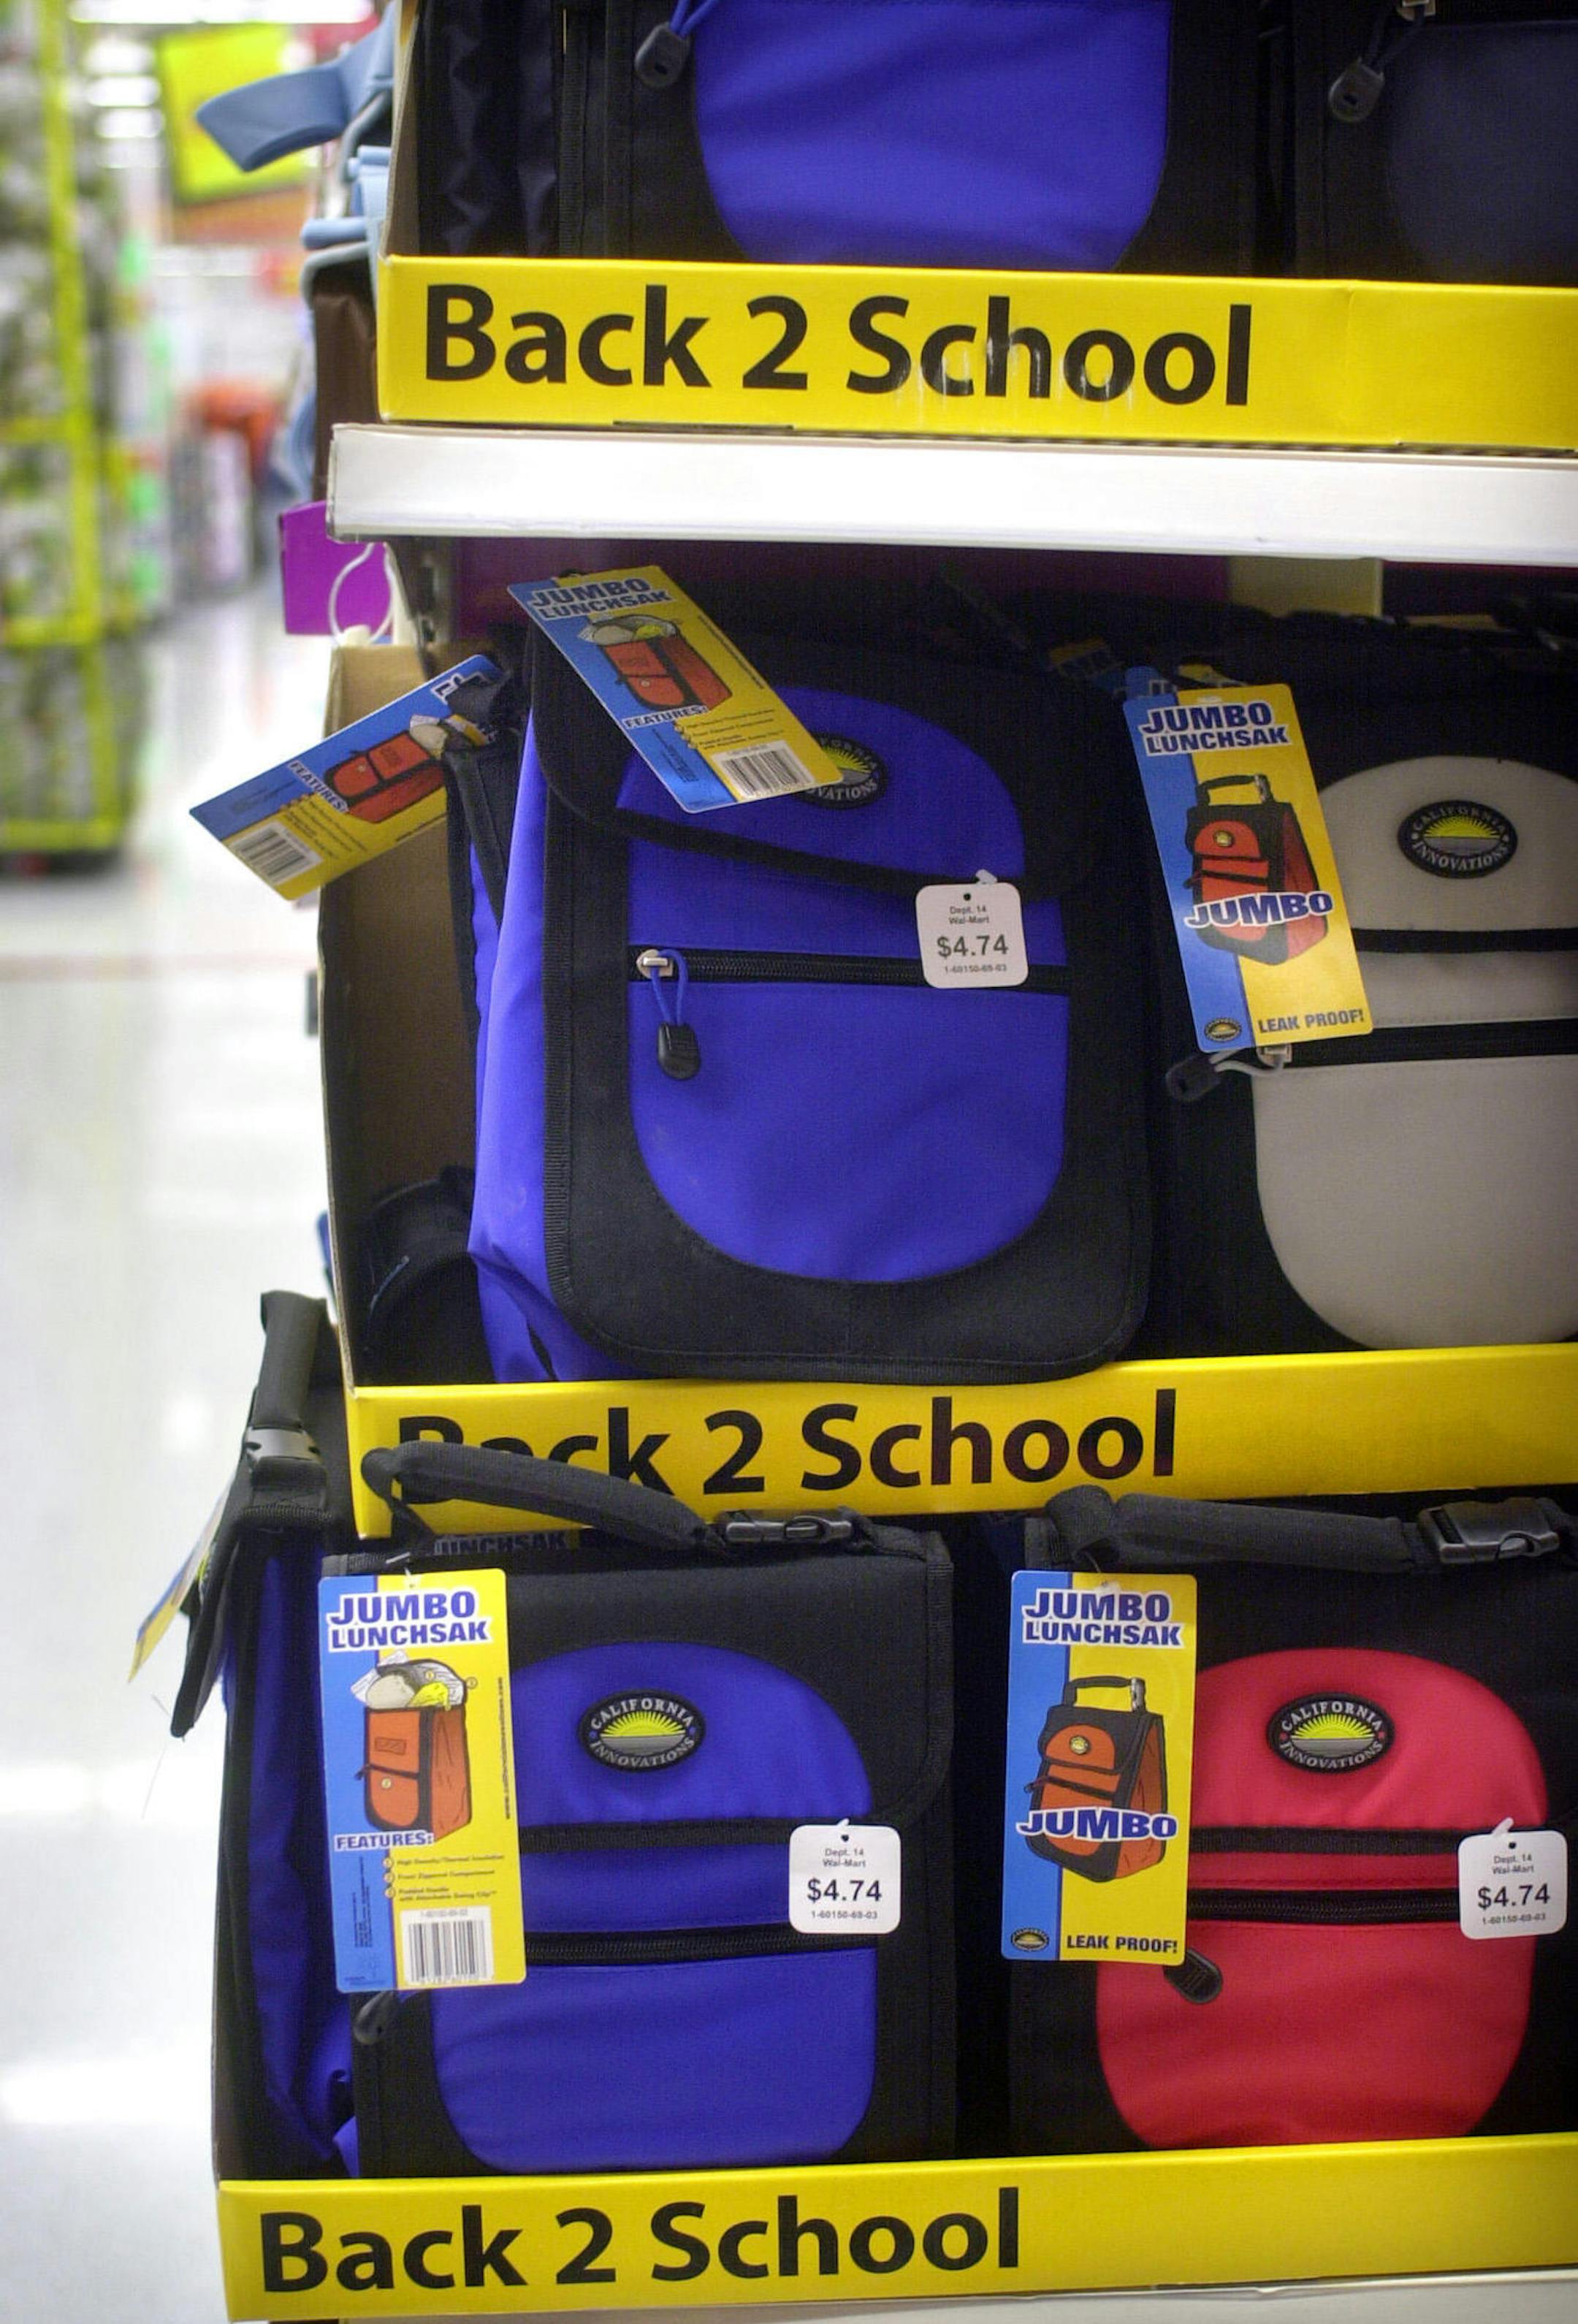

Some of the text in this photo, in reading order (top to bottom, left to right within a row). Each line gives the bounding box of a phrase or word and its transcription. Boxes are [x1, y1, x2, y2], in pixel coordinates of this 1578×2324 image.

[426, 284, 1251, 405] Back 2 School
[530, 578, 651, 606] JUMBO
[537, 591, 671, 619] LUNCHSAK
[626, 706, 709, 727] FEATURES:
[1143, 703, 1272, 734] JUMBO
[1146, 727, 1288, 753] LUNCHSAK
[1411, 840, 1508, 871] INNOVATIONS
[949, 916, 989, 924] Wal-Mart
[1187, 892, 1333, 926] JUMBO
[937, 934, 1009, 959] $4.74
[1259, 1015, 1300, 1034] LEAK
[1306, 1010, 1365, 1029] PROOF!
[704, 1410, 765, 1495] 2
[801, 1388, 1176, 1490] School
[331, 1590, 475, 1625] JUMBO
[1024, 1591, 1169, 1622] JUMBO
[332, 1620, 488, 1648] LUNCHSAK
[1026, 1622, 1181, 1645] LUNCHSAK
[590, 1697, 694, 1730] CALIFORNIA
[1281, 1701, 1383, 1731] CALIFORNIA
[590, 1737, 694, 1767] INNOVATIONS
[1280, 1741, 1383, 1768] INNOVATIONS
[1018, 1810, 1177, 1840] JUMBO
[336, 1832, 433, 1850] FEATURES:
[825, 1848, 864, 1858] Dept. 14
[823, 1859, 866, 1868] Wal-Mart
[1493, 1865, 1534, 1875] Wal-Mart
[1522, 1854, 1532, 1862] 14
[807, 1877, 883, 1904] $4.74
[1477, 1883, 1550, 1910] $4.74
[1067, 1935, 1109, 1949] LEAK
[1116, 1936, 1178, 1954] PROOF!
[260, 2187, 1020, 2293] Back 2 School
